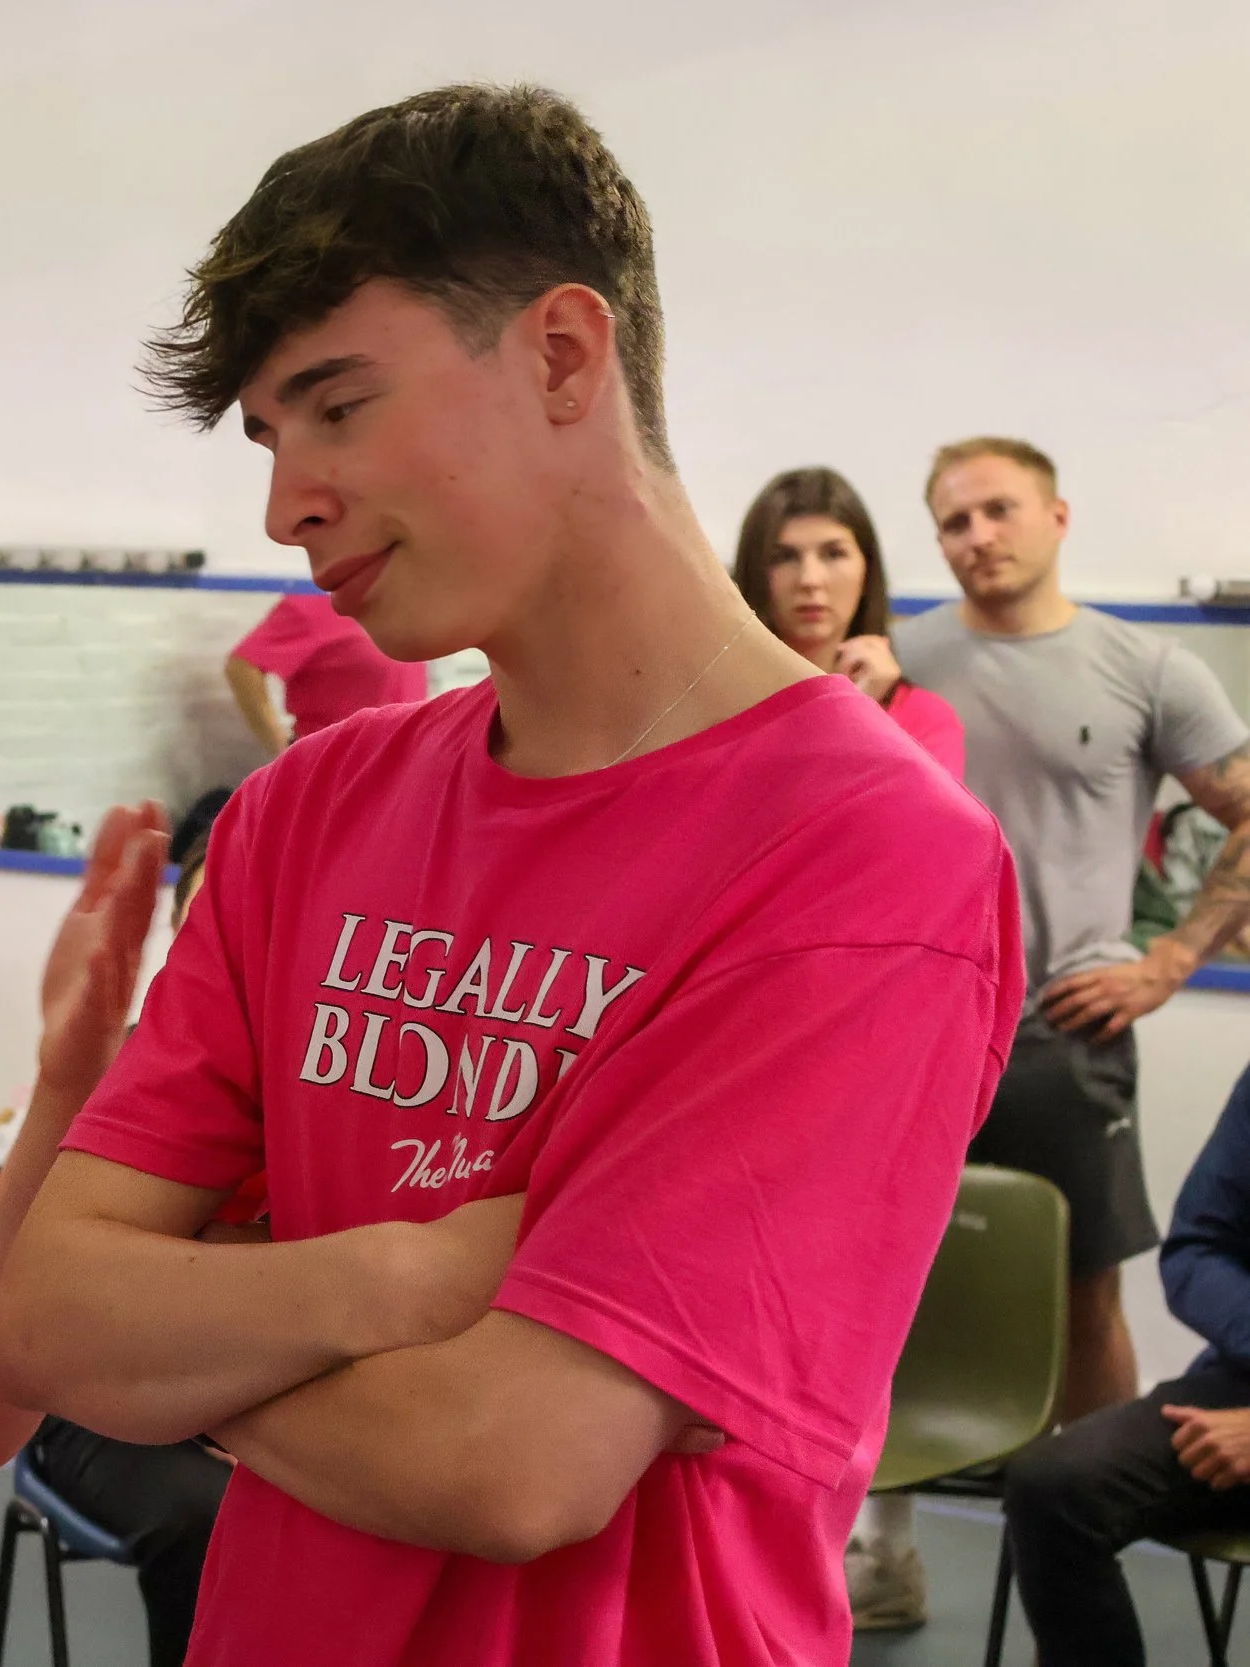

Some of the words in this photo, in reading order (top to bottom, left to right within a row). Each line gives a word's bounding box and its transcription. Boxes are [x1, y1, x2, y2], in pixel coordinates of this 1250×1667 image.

[320, 912, 647, 1040] LEGALLY
[298, 1002, 579, 1123] BLOND
[390, 1138, 447, 1193] The
